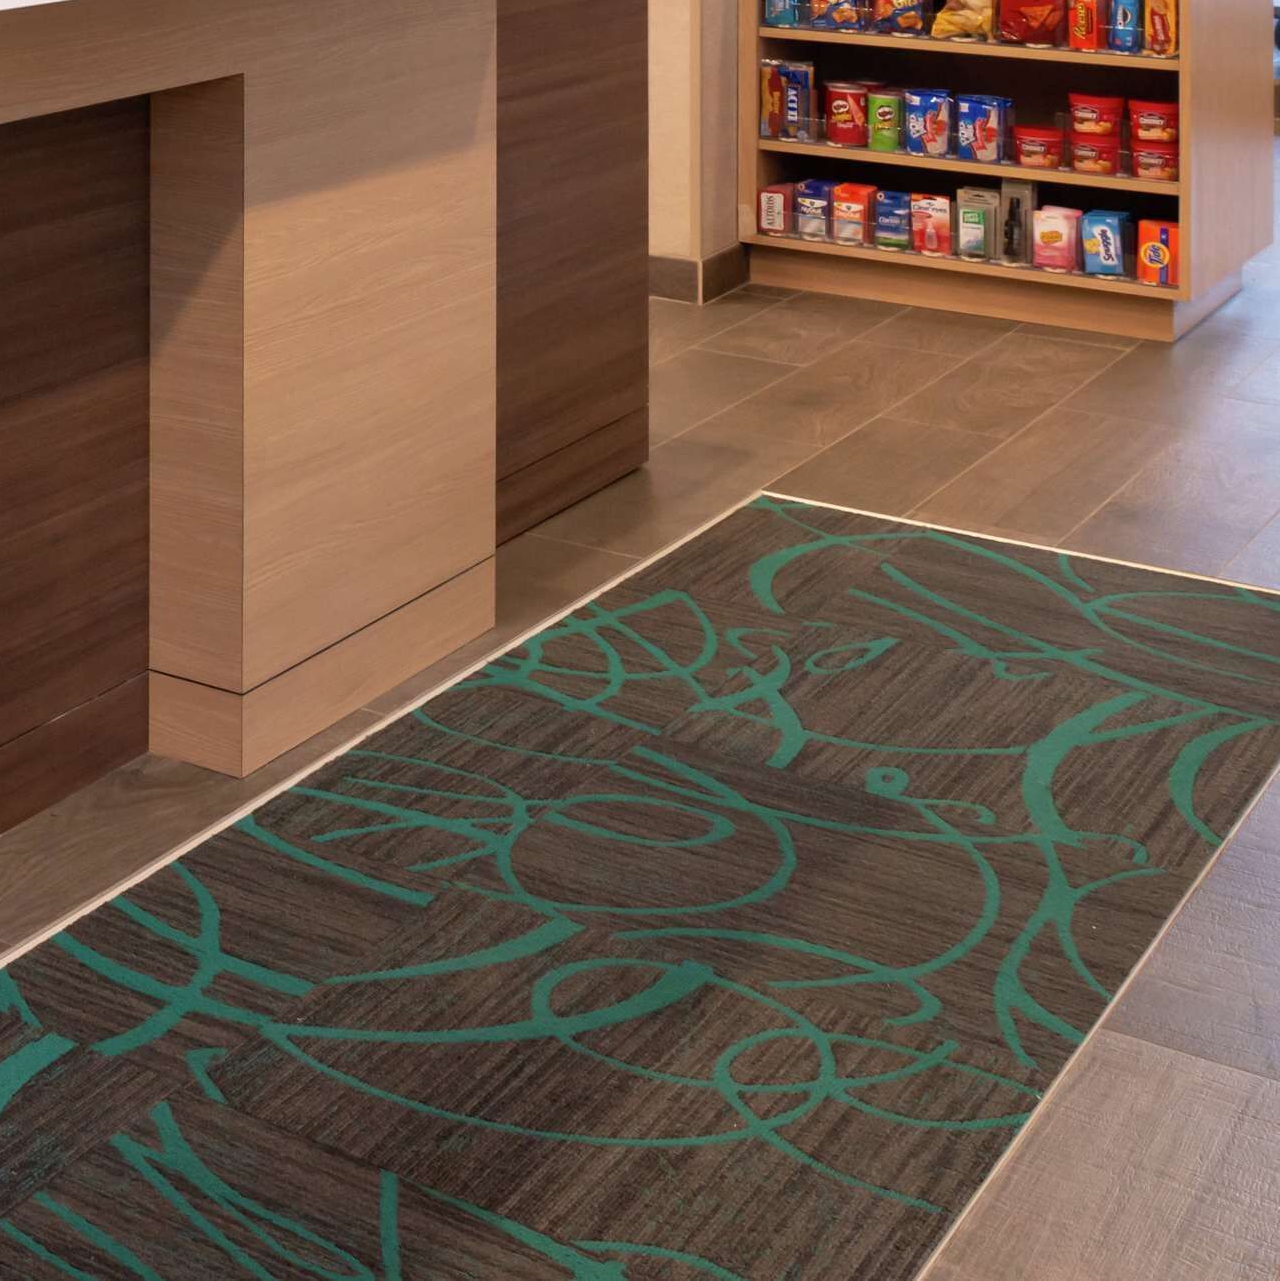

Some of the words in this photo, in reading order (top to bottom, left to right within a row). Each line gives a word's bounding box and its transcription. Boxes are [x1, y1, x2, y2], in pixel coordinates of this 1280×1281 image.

[767, 195, 775, 226] ALTOIDS
[1098, 228, 1115, 263] Snuggle
[1148, 244, 1164, 265] Tide
